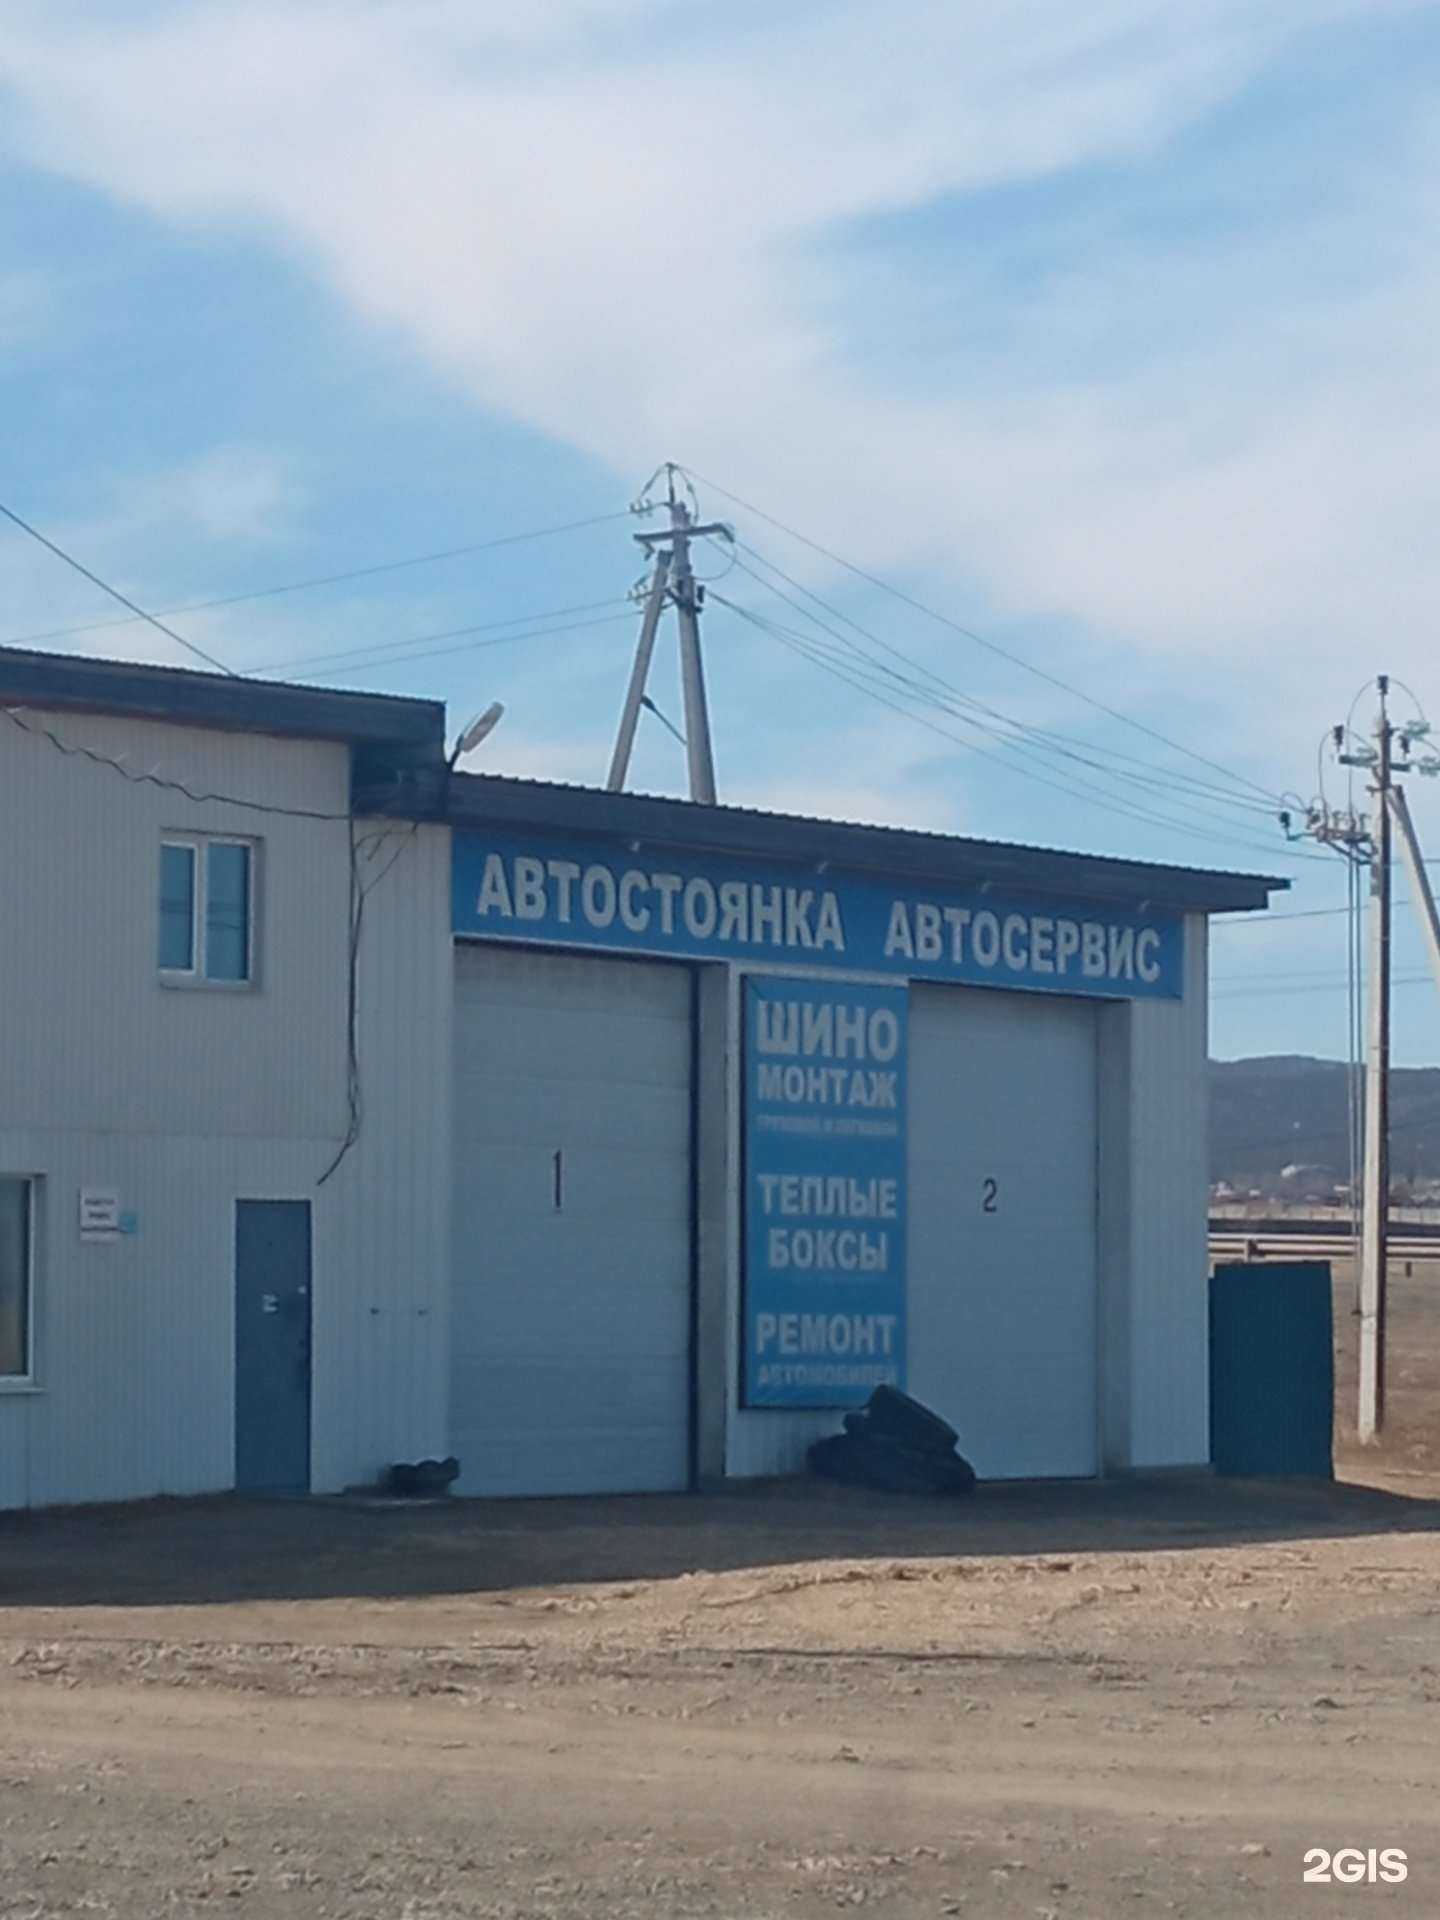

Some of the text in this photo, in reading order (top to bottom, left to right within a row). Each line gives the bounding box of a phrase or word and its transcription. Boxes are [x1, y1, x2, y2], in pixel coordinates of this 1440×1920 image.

[476, 853, 1161, 982] АВТОСТОЯНКА АВТОСЕРВИС
[757, 1000, 898, 1063] ШИНО
[757, 1064, 897, 1108] МОНТАЖ
[756, 1174, 897, 1218] ТЕПЛЫЕ
[983, 1178, 997, 1213] 2
[768, 1228, 888, 1271] БОКСЫ
[756, 1313, 896, 1355] РЕМОНТ
